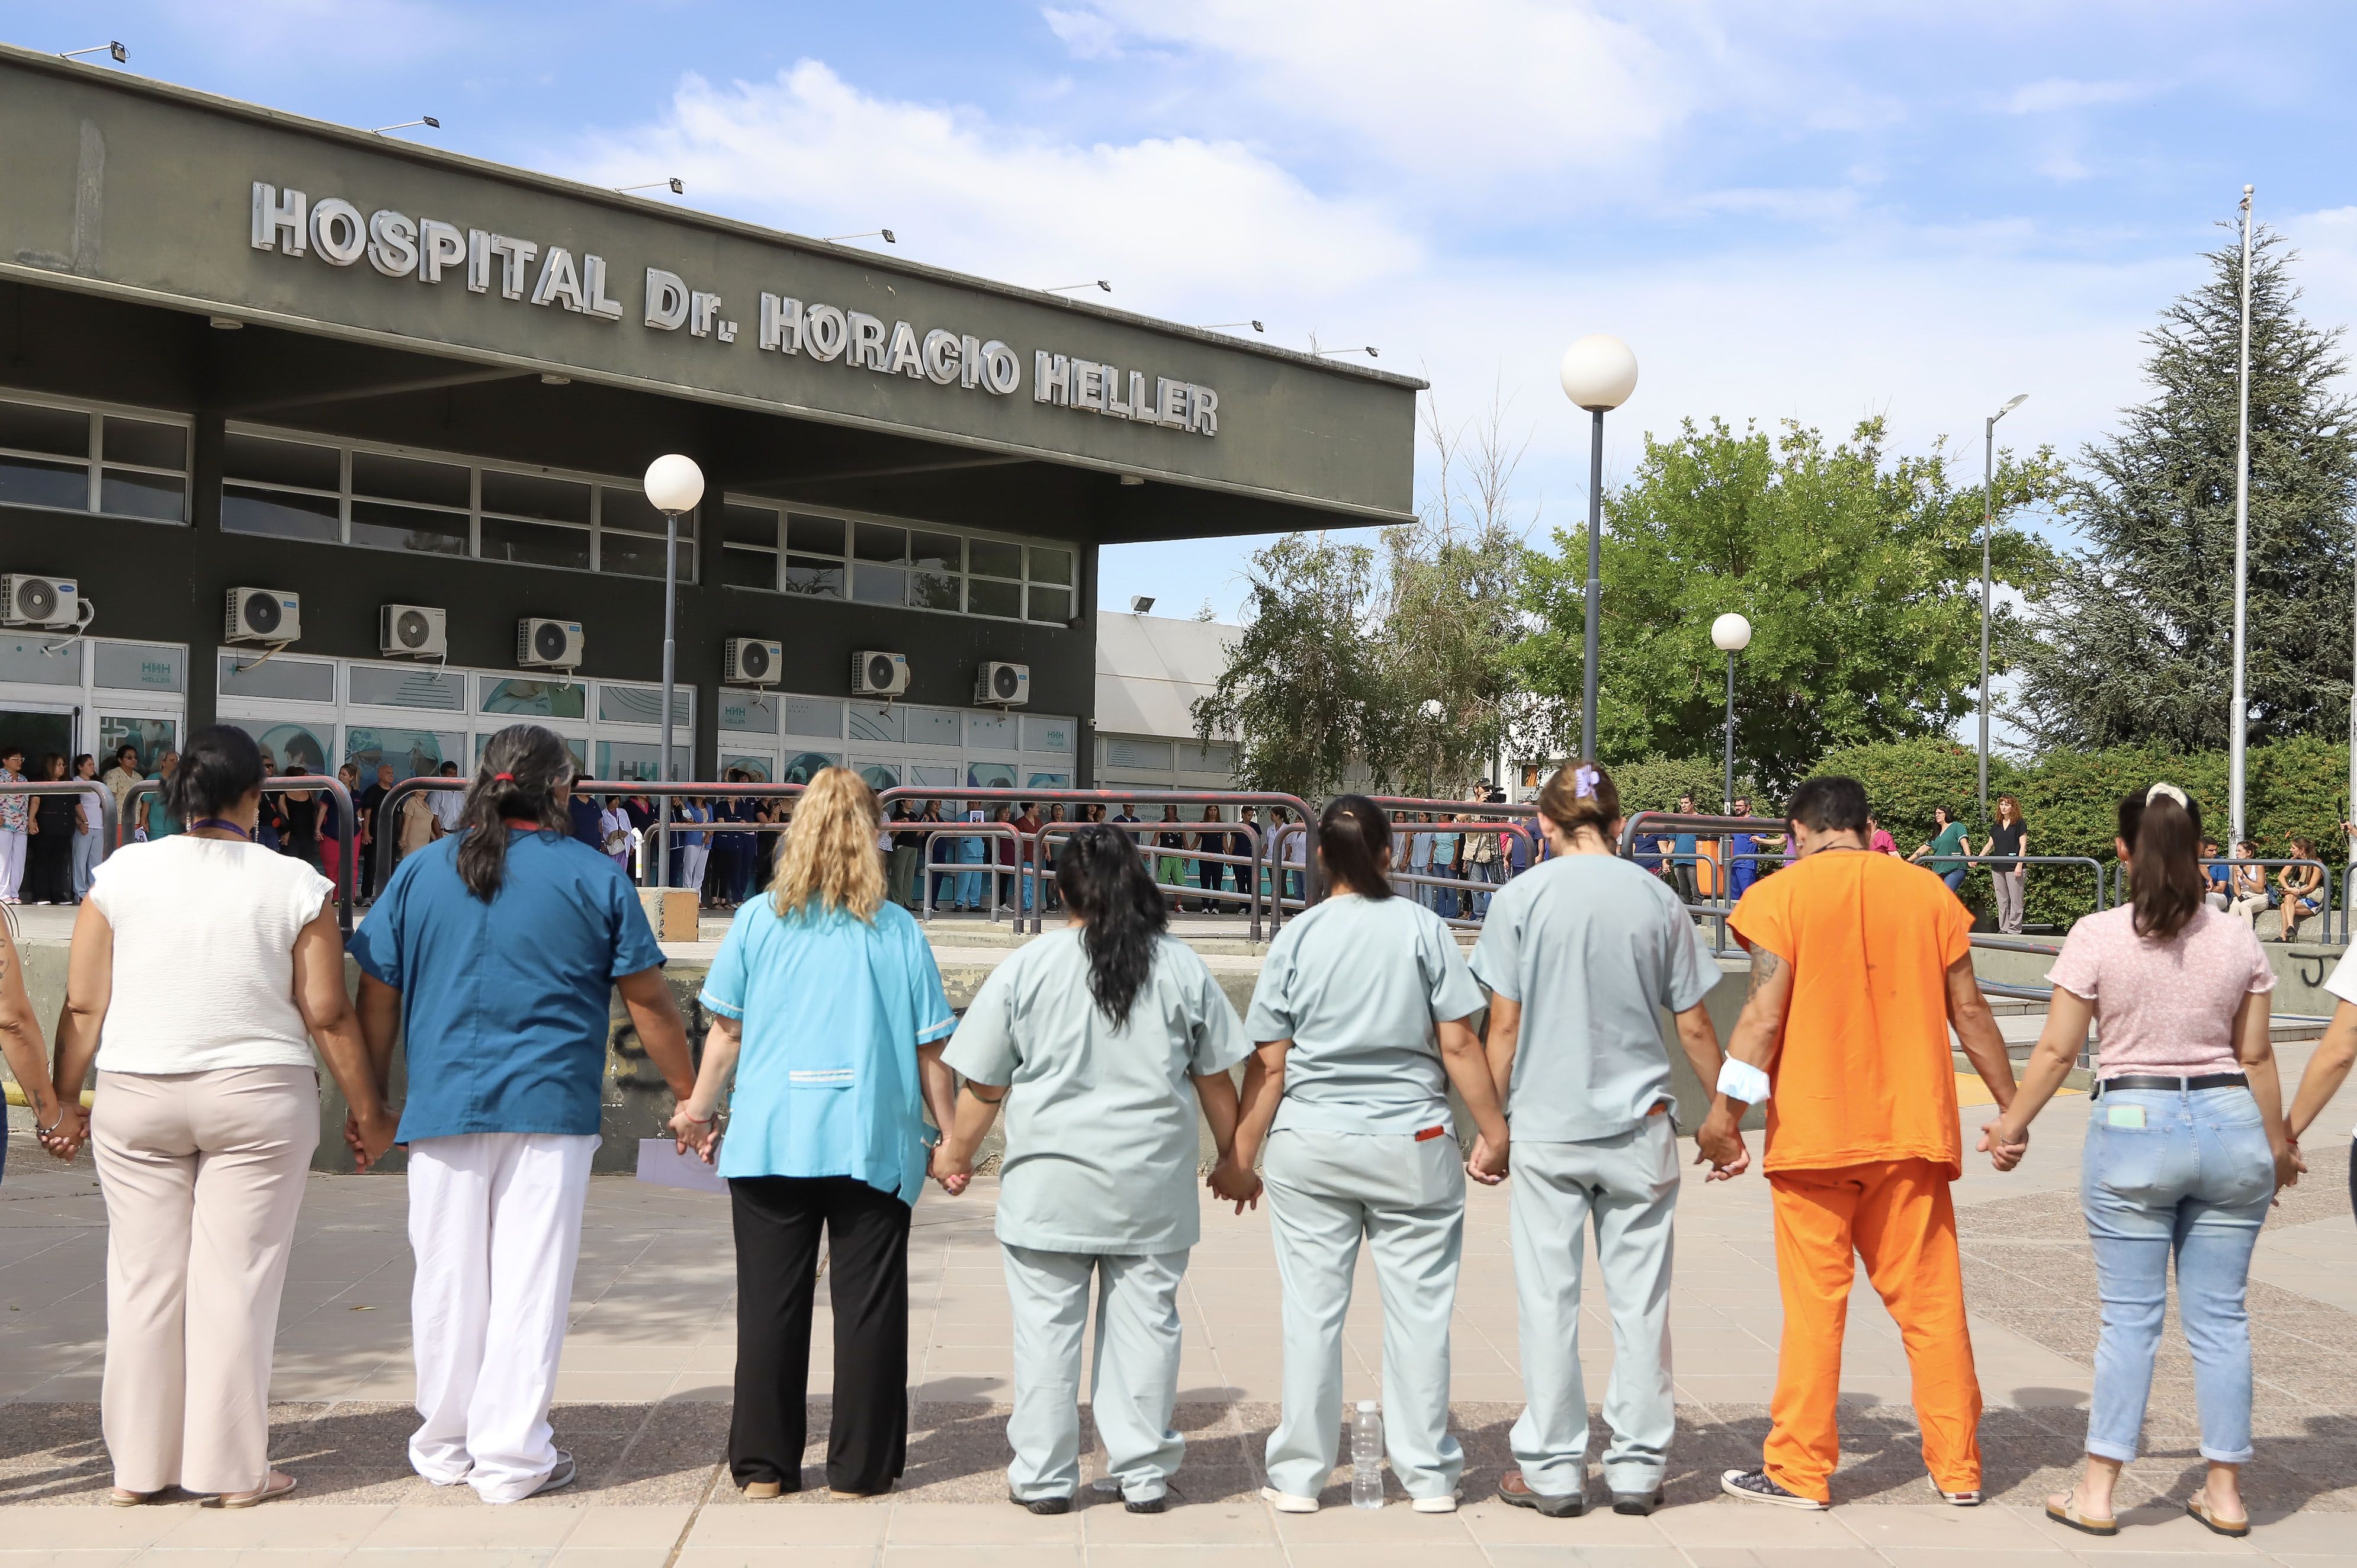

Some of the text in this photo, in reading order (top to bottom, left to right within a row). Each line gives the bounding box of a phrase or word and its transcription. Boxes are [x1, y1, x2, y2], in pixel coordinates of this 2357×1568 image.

[251, 181, 1219, 436] HOSPITAL Dr. HORACIO HELLER
